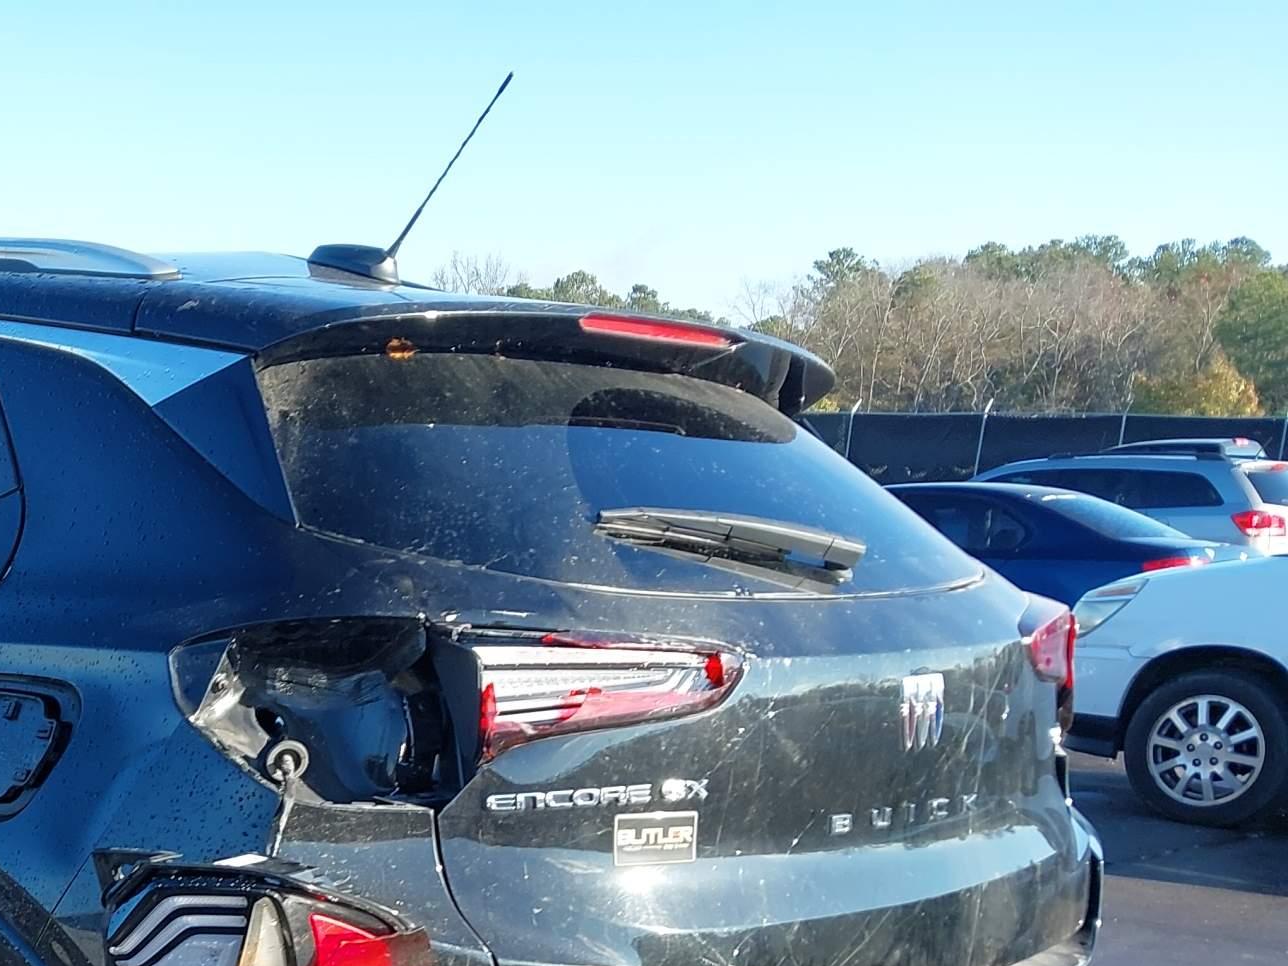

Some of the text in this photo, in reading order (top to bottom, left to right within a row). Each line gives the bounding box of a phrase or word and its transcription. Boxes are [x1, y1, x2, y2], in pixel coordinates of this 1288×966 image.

[486, 783, 652, 811] ENCORE
[827, 793, 978, 835] BUICK
[617, 826, 693, 846] BUTLER
